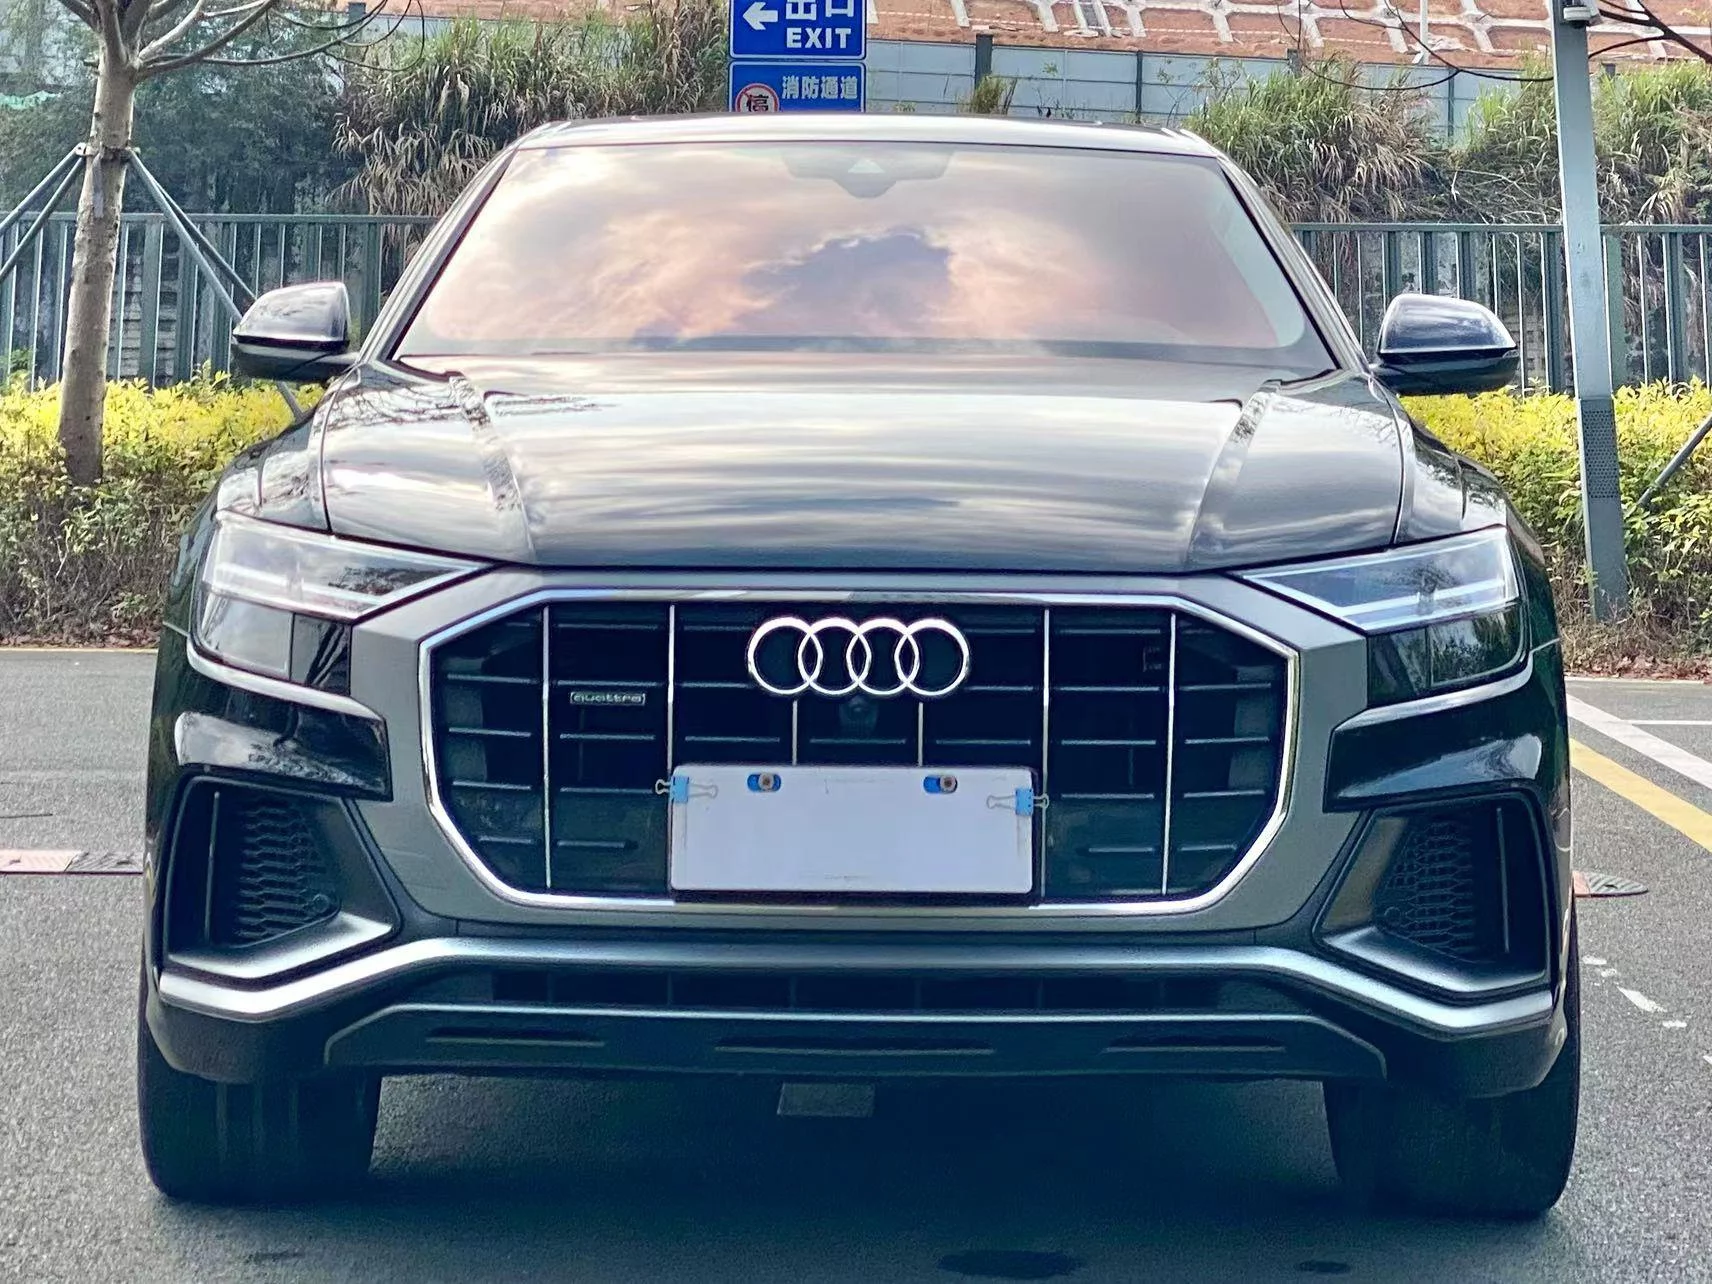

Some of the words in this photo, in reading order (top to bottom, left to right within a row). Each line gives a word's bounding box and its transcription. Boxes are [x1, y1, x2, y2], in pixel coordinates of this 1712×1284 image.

[786, 27, 852, 49] EXIT
[782, 75, 858, 100] 消防通道
[573, 692, 642, 703] quattro
